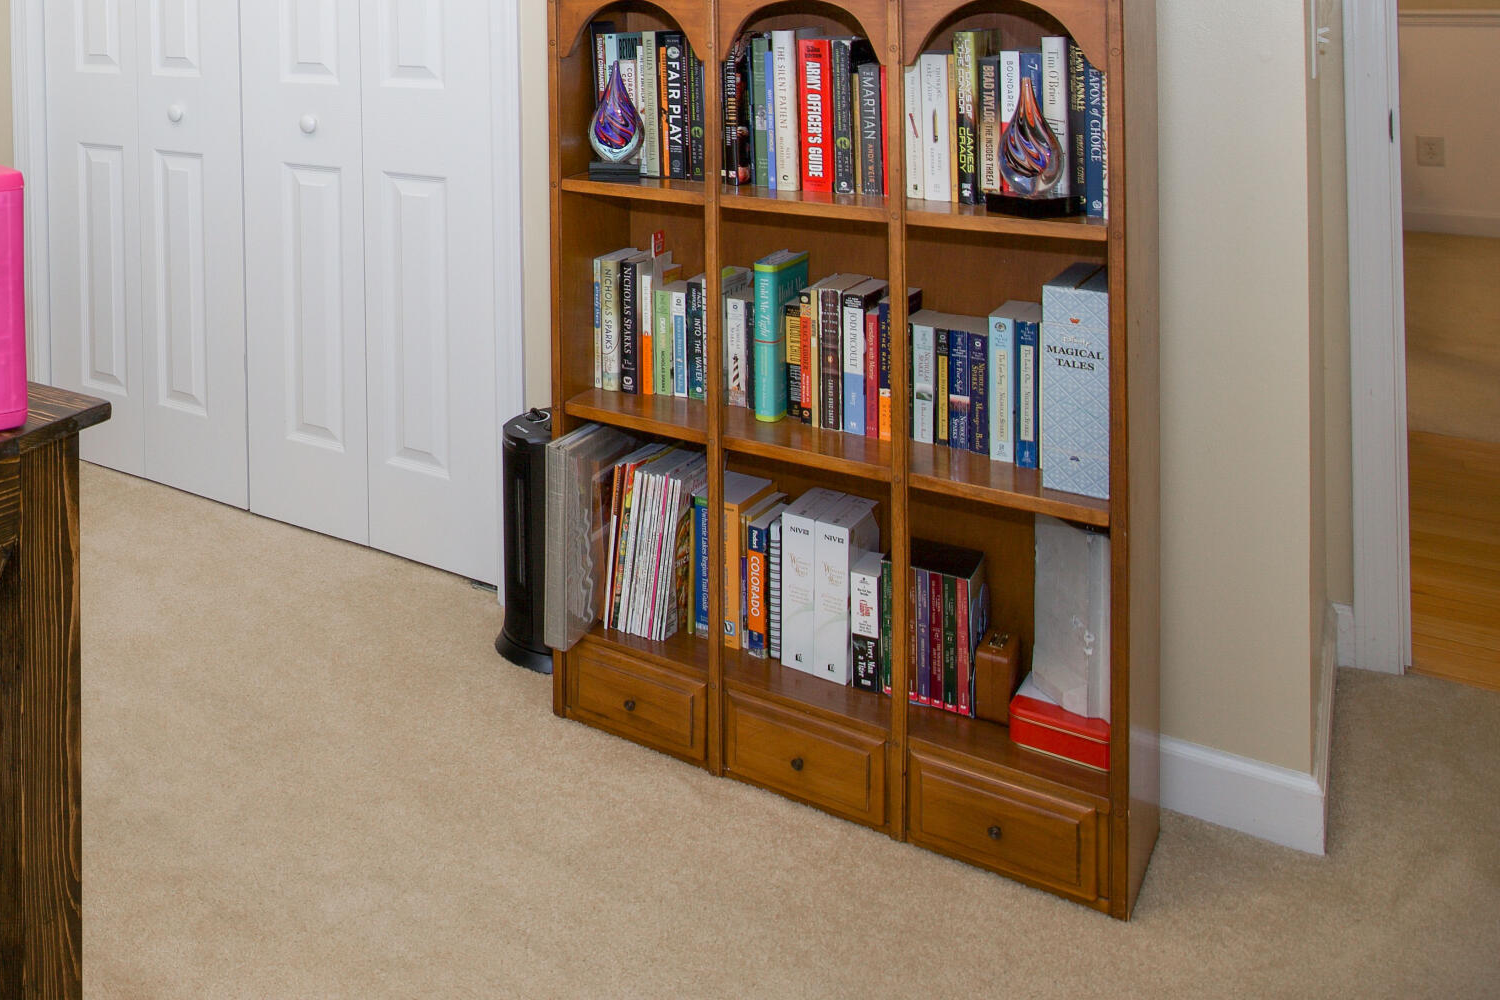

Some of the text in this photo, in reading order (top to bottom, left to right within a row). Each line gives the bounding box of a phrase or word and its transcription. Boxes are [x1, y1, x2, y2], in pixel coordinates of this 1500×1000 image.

[964, 39, 972, 69] LAST
[1047, 49, 1059, 69] Tim
[668, 61, 681, 99] FAIR
[727, 72, 737, 121] FORCES BERLIN
[777, 46, 788, 129] THE SILENT PATIENT
[983, 65, 995, 123] BRAD TAYLOR
[1006, 60, 1014, 113] BOUNDARIES
[1049, 70, 1060, 105] O'Brien
[1075, 47, 1086, 112] TEAM YANKEE
[669, 104, 682, 145] PLAY
[806, 61, 823, 178] ARMY OFFICER'S GUIDE
[862, 77, 877, 139] MARTIAN
[966, 103, 973, 119] OF
[1088, 69, 1102, 162] EAPON of CHOICE
[958, 127, 966, 173] GRADY
[966, 127, 975, 173] JAMES
[986, 163, 994, 185] THREAT
[604, 269, 612, 316] NICHOLAS
[623, 267, 632, 315] NICHOLAS
[759, 278, 769, 299] Hold
[760, 299, 769, 313] Me
[849, 311, 858, 332] JODI
[604, 319, 613, 350] SPARKS
[623, 317, 632, 354] SPARKS
[757, 314, 771, 337] Tight
[790, 319, 801, 343] LINCOLN
[881, 321, 886, 329] IN
[850, 333, 858, 368] PICOULT
[1046, 344, 1104, 360] MAGICAL
[1056, 358, 1094, 371] TALES
[790, 364, 801, 379] DEEP
[790, 380, 801, 402] STORM
[700, 556, 708, 577] Region
[750, 556, 760, 617] COLORADO
[858, 661, 866, 678] Tiger
[866, 641, 876, 674] Every Man
